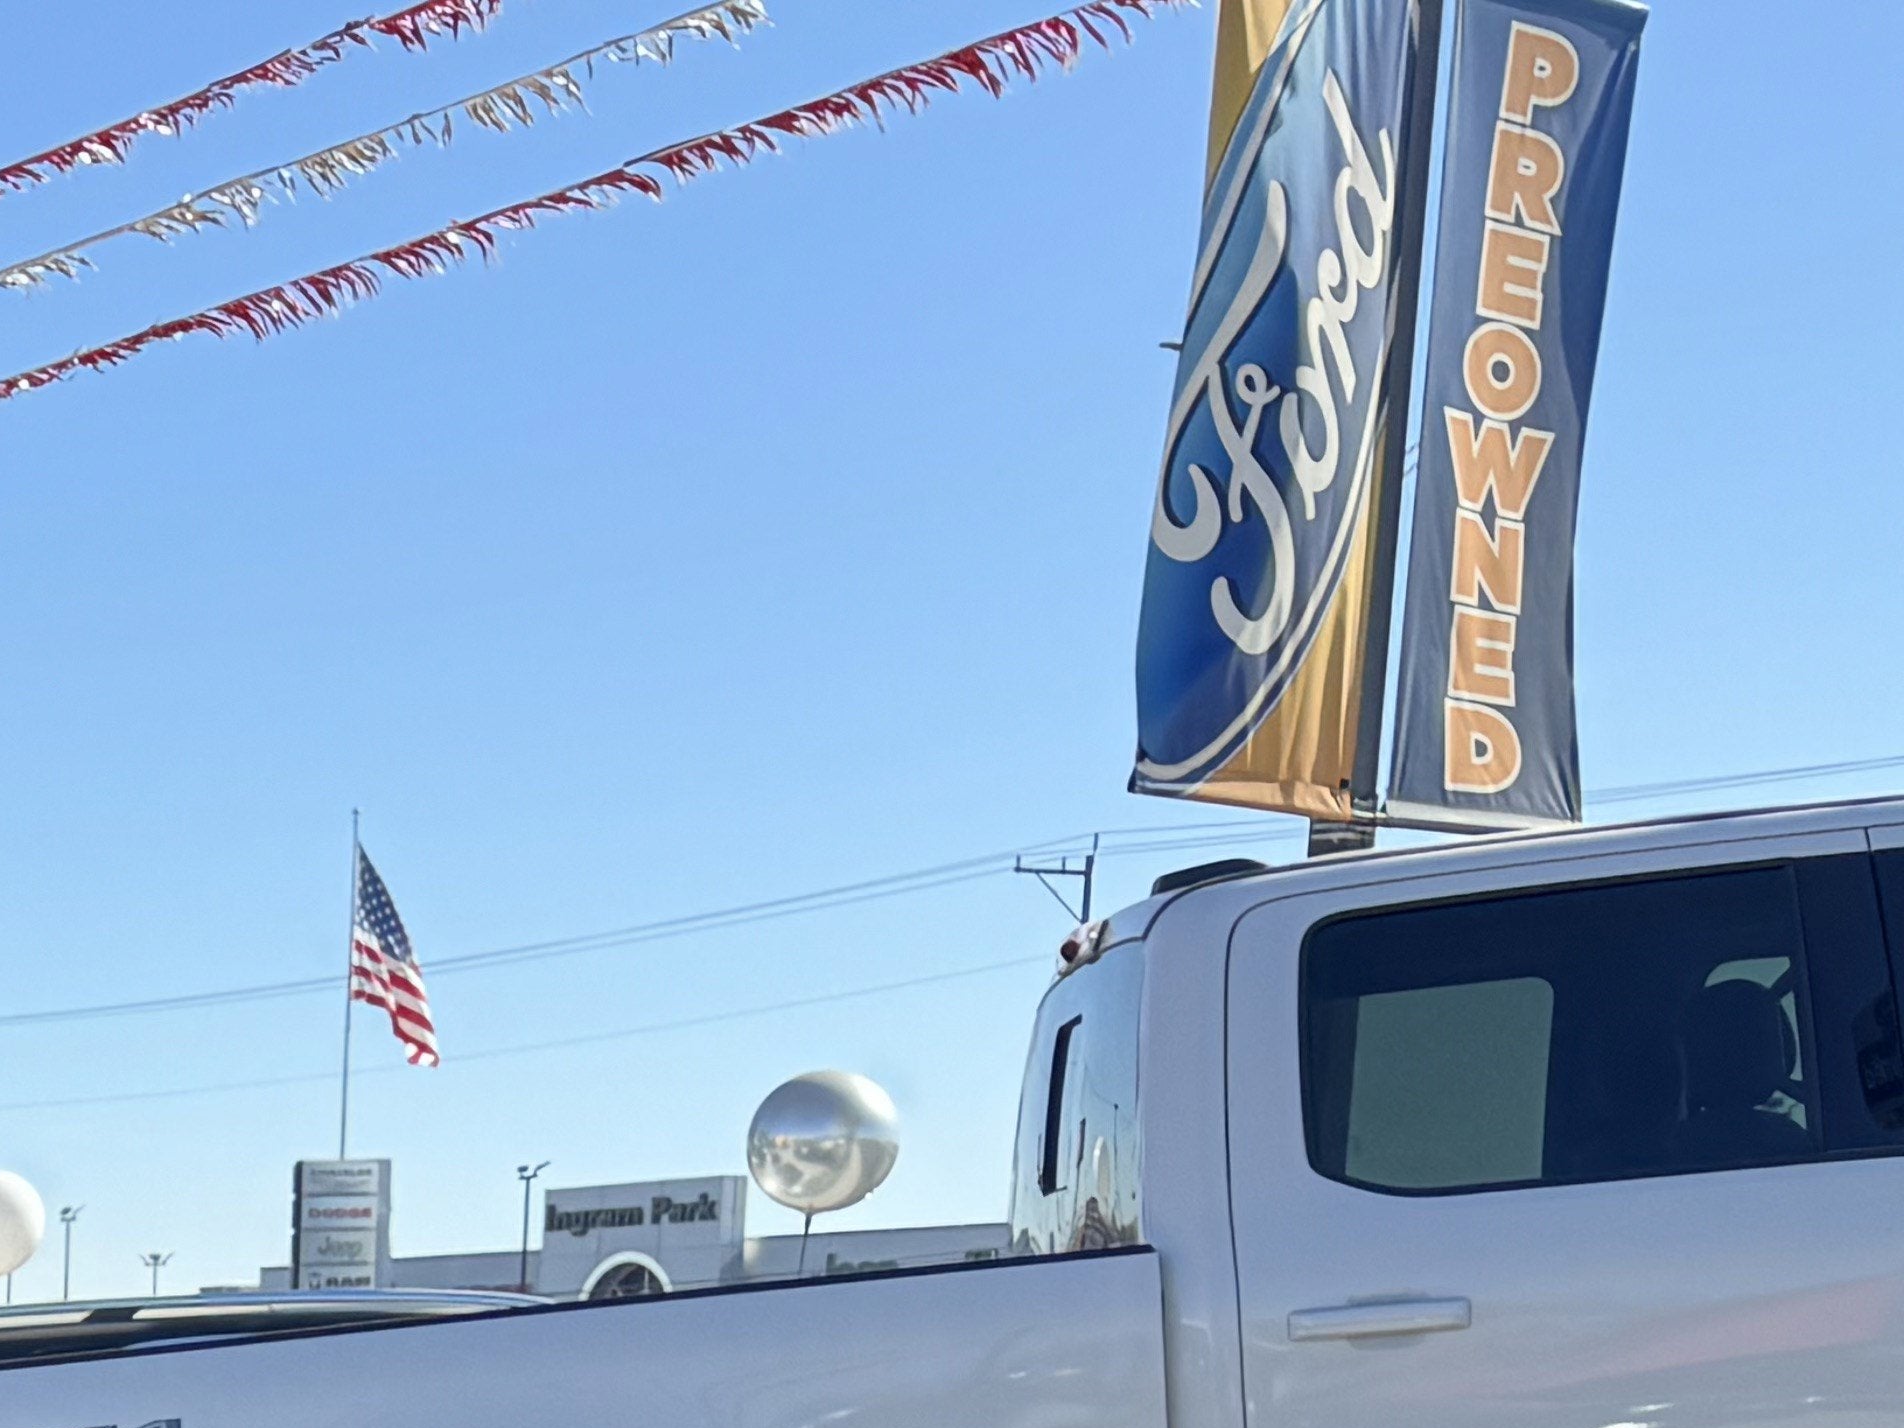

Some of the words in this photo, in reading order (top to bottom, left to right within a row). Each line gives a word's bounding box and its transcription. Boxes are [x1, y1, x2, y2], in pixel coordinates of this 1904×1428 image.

[1152, 66, 1396, 656] Ford
[1444, 20, 1579, 794] PREOWNED
[545, 1204, 644, 1236] Ingram
[651, 1192, 718, 1225] Park
